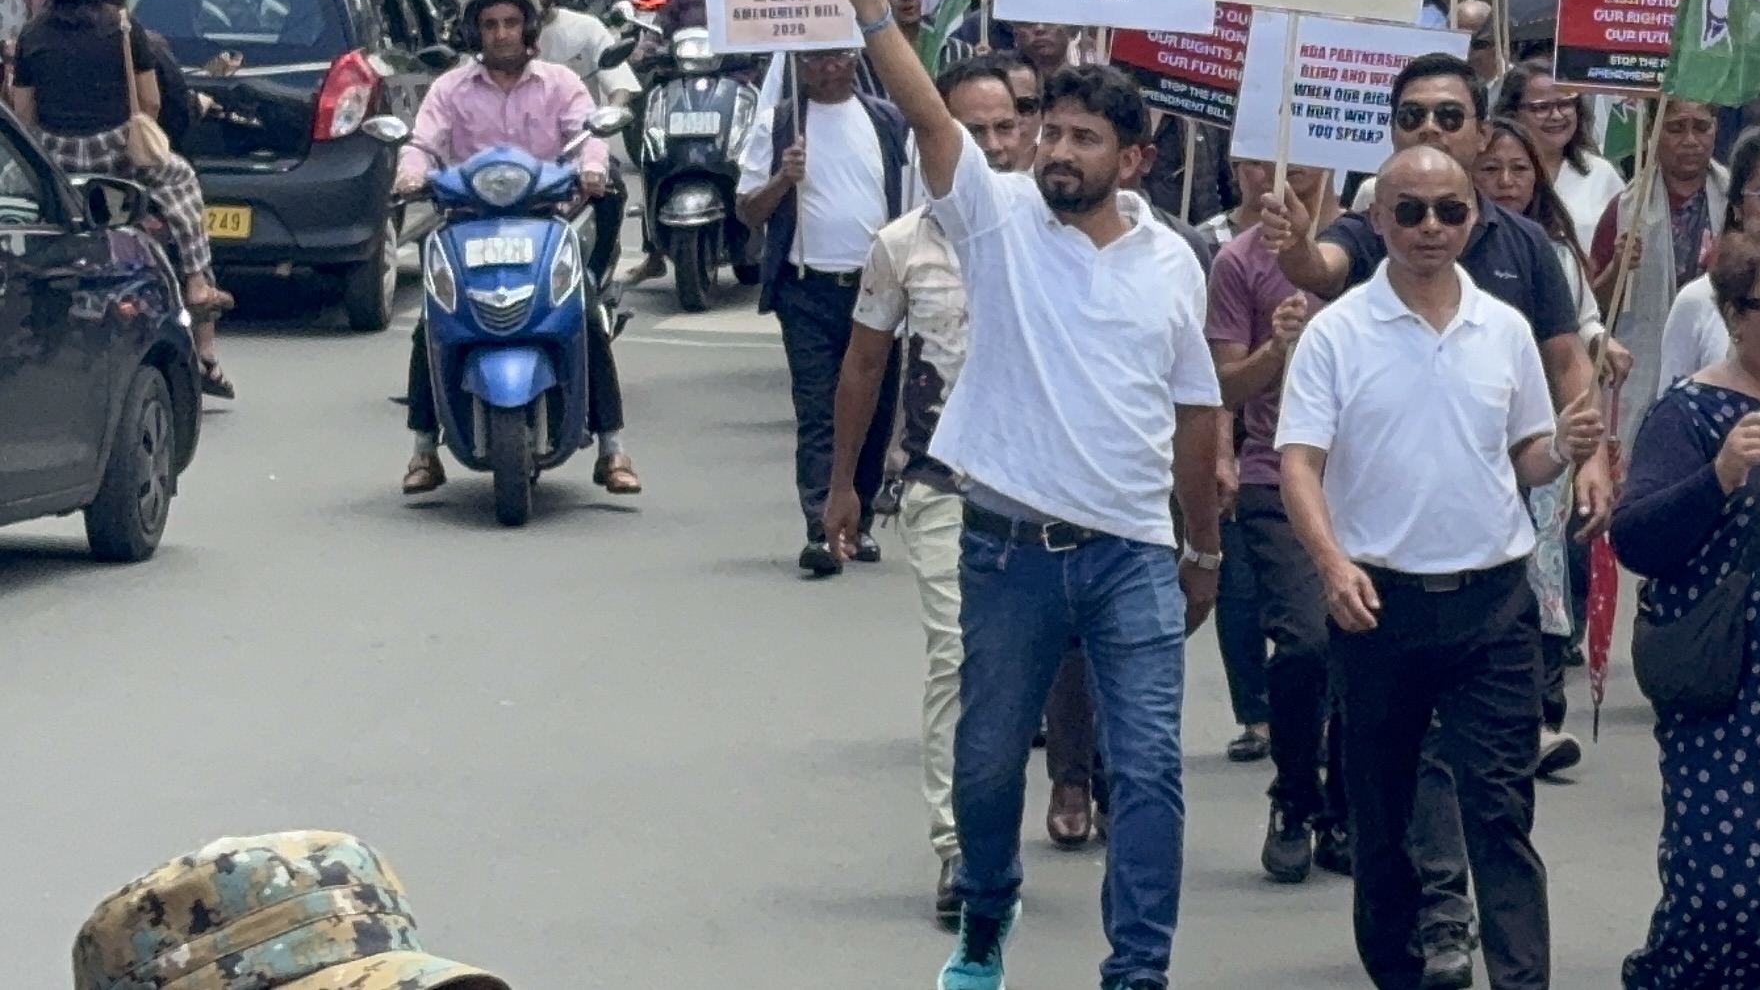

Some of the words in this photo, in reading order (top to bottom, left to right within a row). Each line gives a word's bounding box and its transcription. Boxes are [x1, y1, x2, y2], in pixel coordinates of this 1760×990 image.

[732, 6, 810, 22] AMENDMENT
[1228, 11, 1249, 25] OU
[1593, 9, 1624, 23] OUR
[772, 23, 807, 37] 2026
[1605, 28, 1636, 43] OUR
[1148, 31, 1178, 47] OUR
[1180, 38, 1233, 60] RIGHTS
[1157, 51, 1188, 70] OUR
[1610, 55, 1638, 67] STOP
[1340, 68, 1366, 84] AND
[1587, 67, 1656, 82] AMENDMENT
[1160, 78, 1188, 92] STOP
[1190, 84, 1209, 99] THE
[1211, 90, 1236, 106] FCR
[1294, 82, 1332, 101] WHEN
[1334, 87, 1360, 103] OUR
[1344, 109, 1374, 124] WHY
[1308, 123, 1333, 140] YOU
[1335, 126, 1384, 144] SPEAK?
